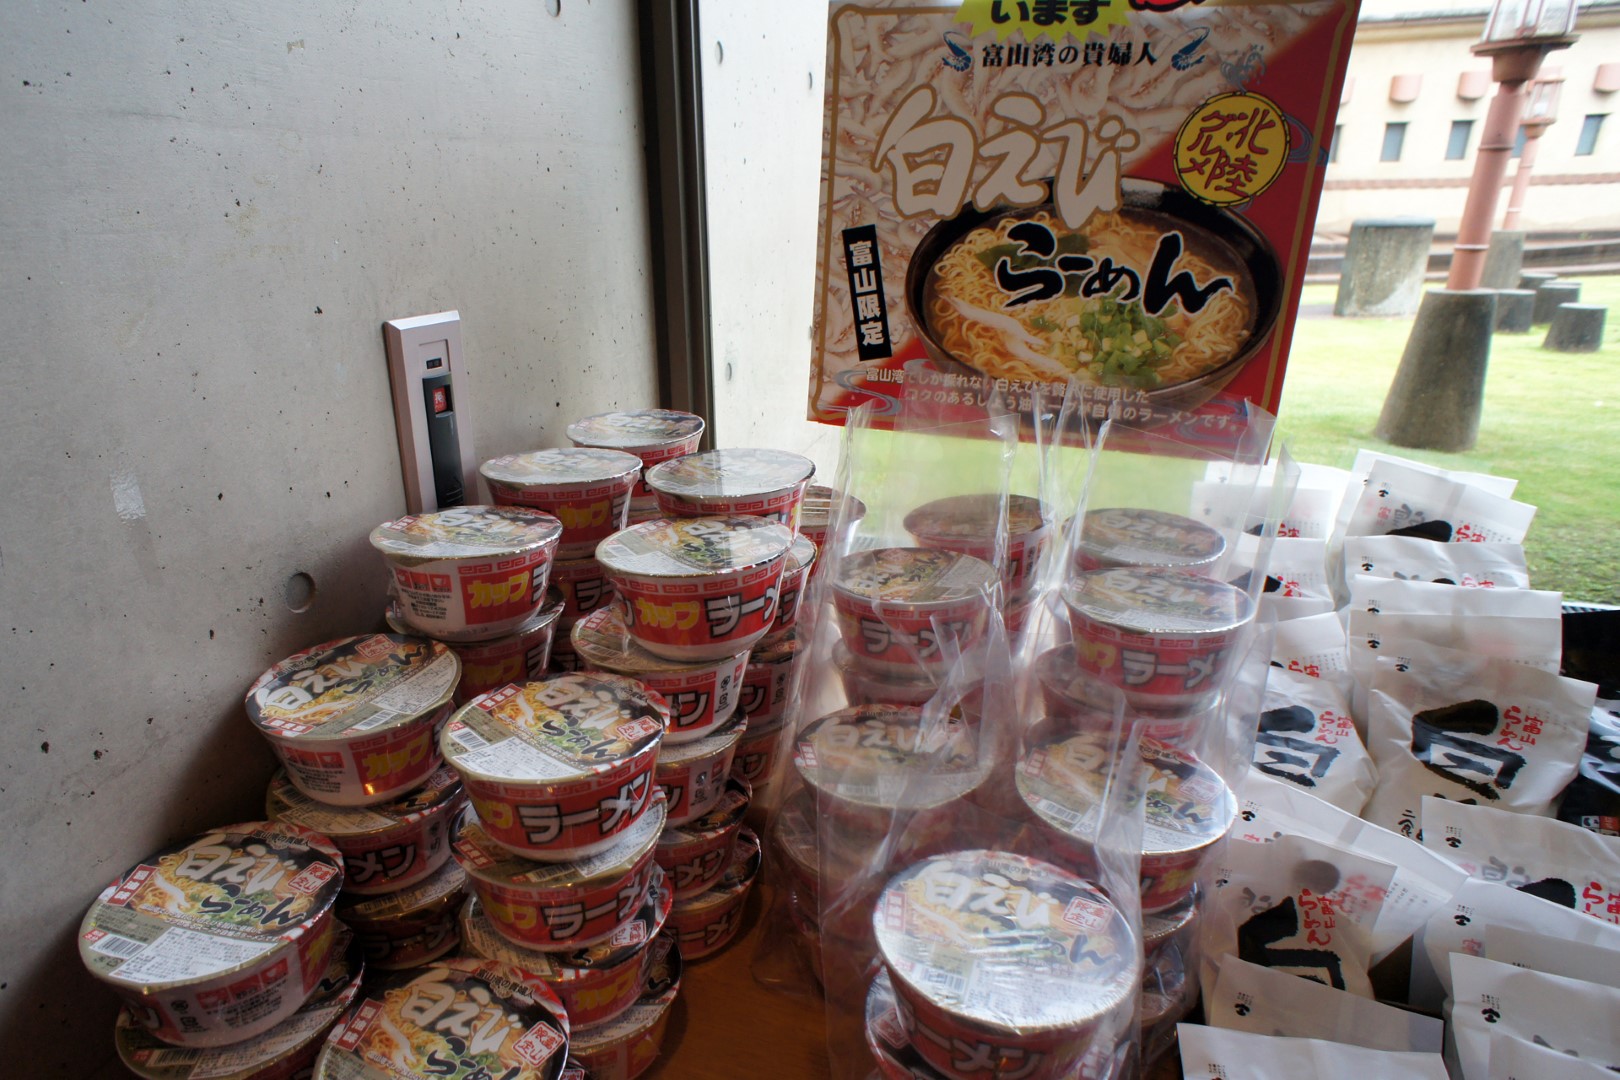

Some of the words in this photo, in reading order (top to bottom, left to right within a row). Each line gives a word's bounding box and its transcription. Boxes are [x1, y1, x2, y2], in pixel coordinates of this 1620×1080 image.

[982, 41, 1158, 68] 富山湾の貴婦人
[871, 84, 1141, 230] 白えび
[847, 239, 886, 347] 富山限定
[995, 221, 1236, 317] らーめん
[467, 569, 530, 609] カップ
[635, 594, 701, 631] カップ
[361, 730, 431, 780] カップ
[1497, 705, 1524, 751] らーめん
[1522, 714, 1544, 746] 富山
[174, 833, 299, 896] 白えび
[197, 883, 307, 926] らーめん
[918, 860, 1060, 928] 白えび
[1298, 887, 1332, 946] らーめん
[399, 968, 524, 1057] 白えび
